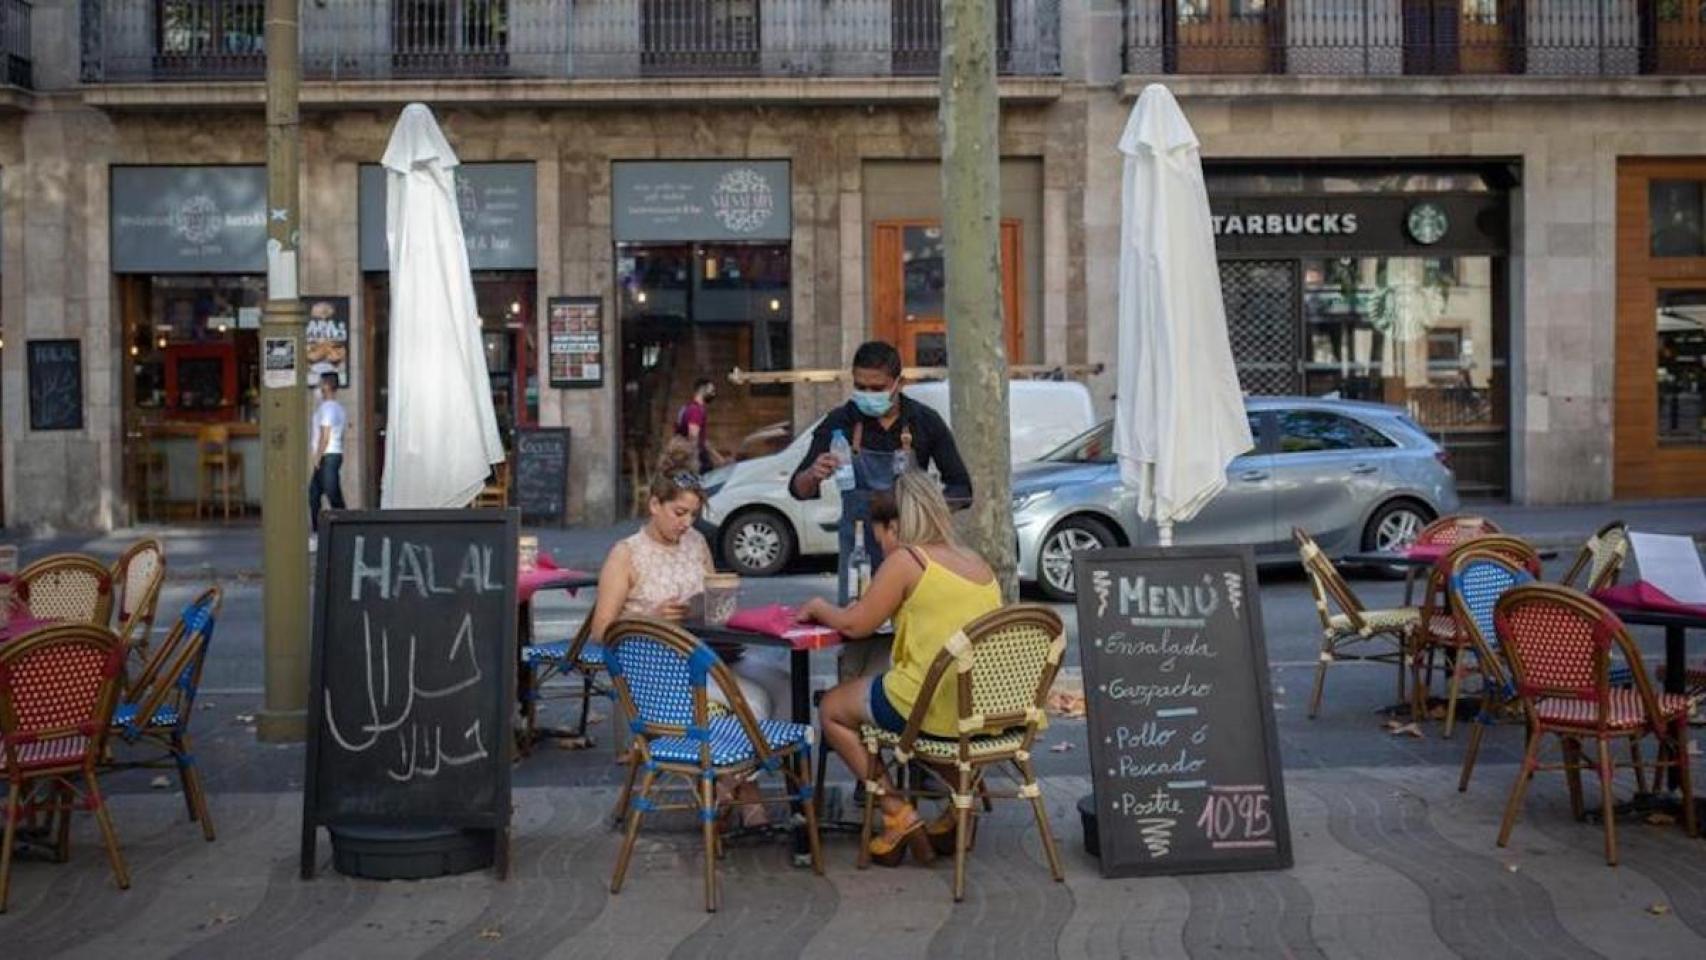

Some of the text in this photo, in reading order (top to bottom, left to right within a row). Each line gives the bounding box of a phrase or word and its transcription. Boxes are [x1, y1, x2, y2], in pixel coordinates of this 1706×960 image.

[1210, 213, 1358, 234] TARBUCKS
[351, 535, 504, 600] HALAL
[1105, 628, 1217, 657] Ensalada
[1109, 672, 1213, 705] Gazpacho
[1116, 722, 1176, 749] Pollo
[1119, 750, 1207, 778] Pescado
[1121, 785, 1184, 816] Postre
